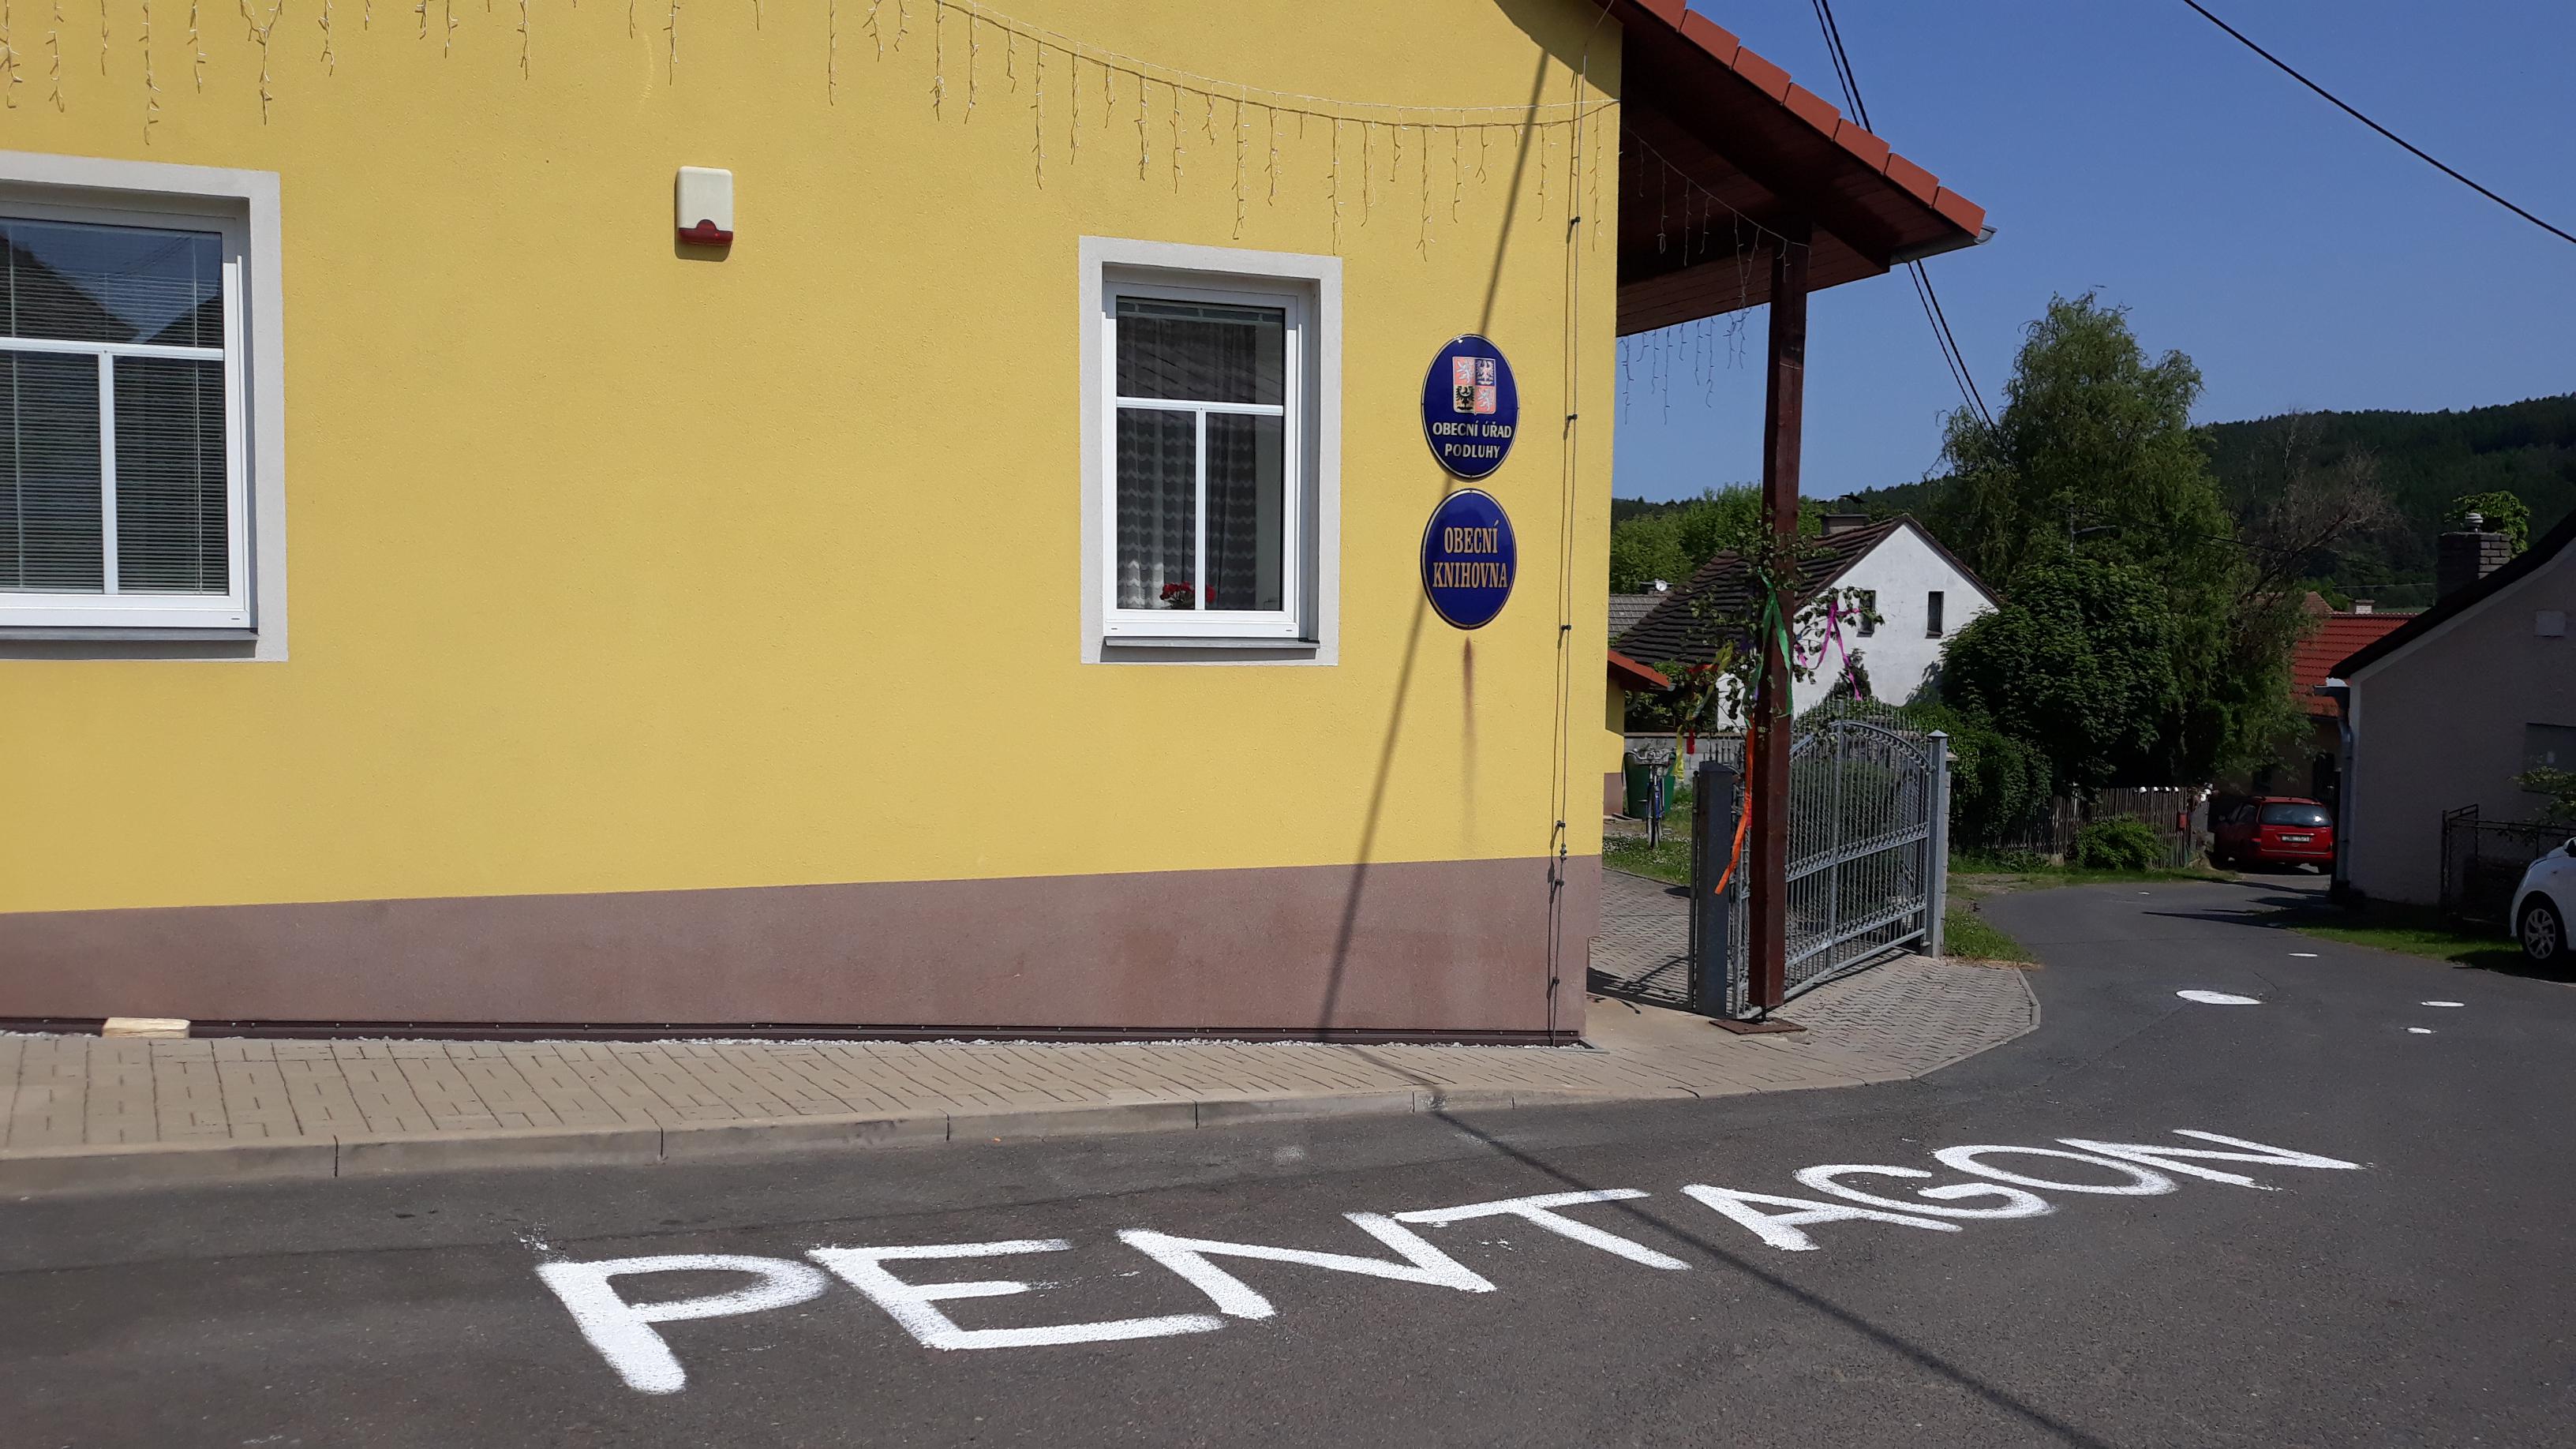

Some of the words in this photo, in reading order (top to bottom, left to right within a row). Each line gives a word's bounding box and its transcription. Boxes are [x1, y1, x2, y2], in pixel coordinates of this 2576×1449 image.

[1432, 420, 1479, 437] OBECNÍ
[1482, 421, 1512, 438] ÚŘAD
[1444, 443, 1500, 459] PODLUHY
[1443, 519, 1500, 554] OBECNÍ
[1432, 561, 1508, 589] KNIHOVNA
[534, 1129, 2364, 1395] PENTAGON
